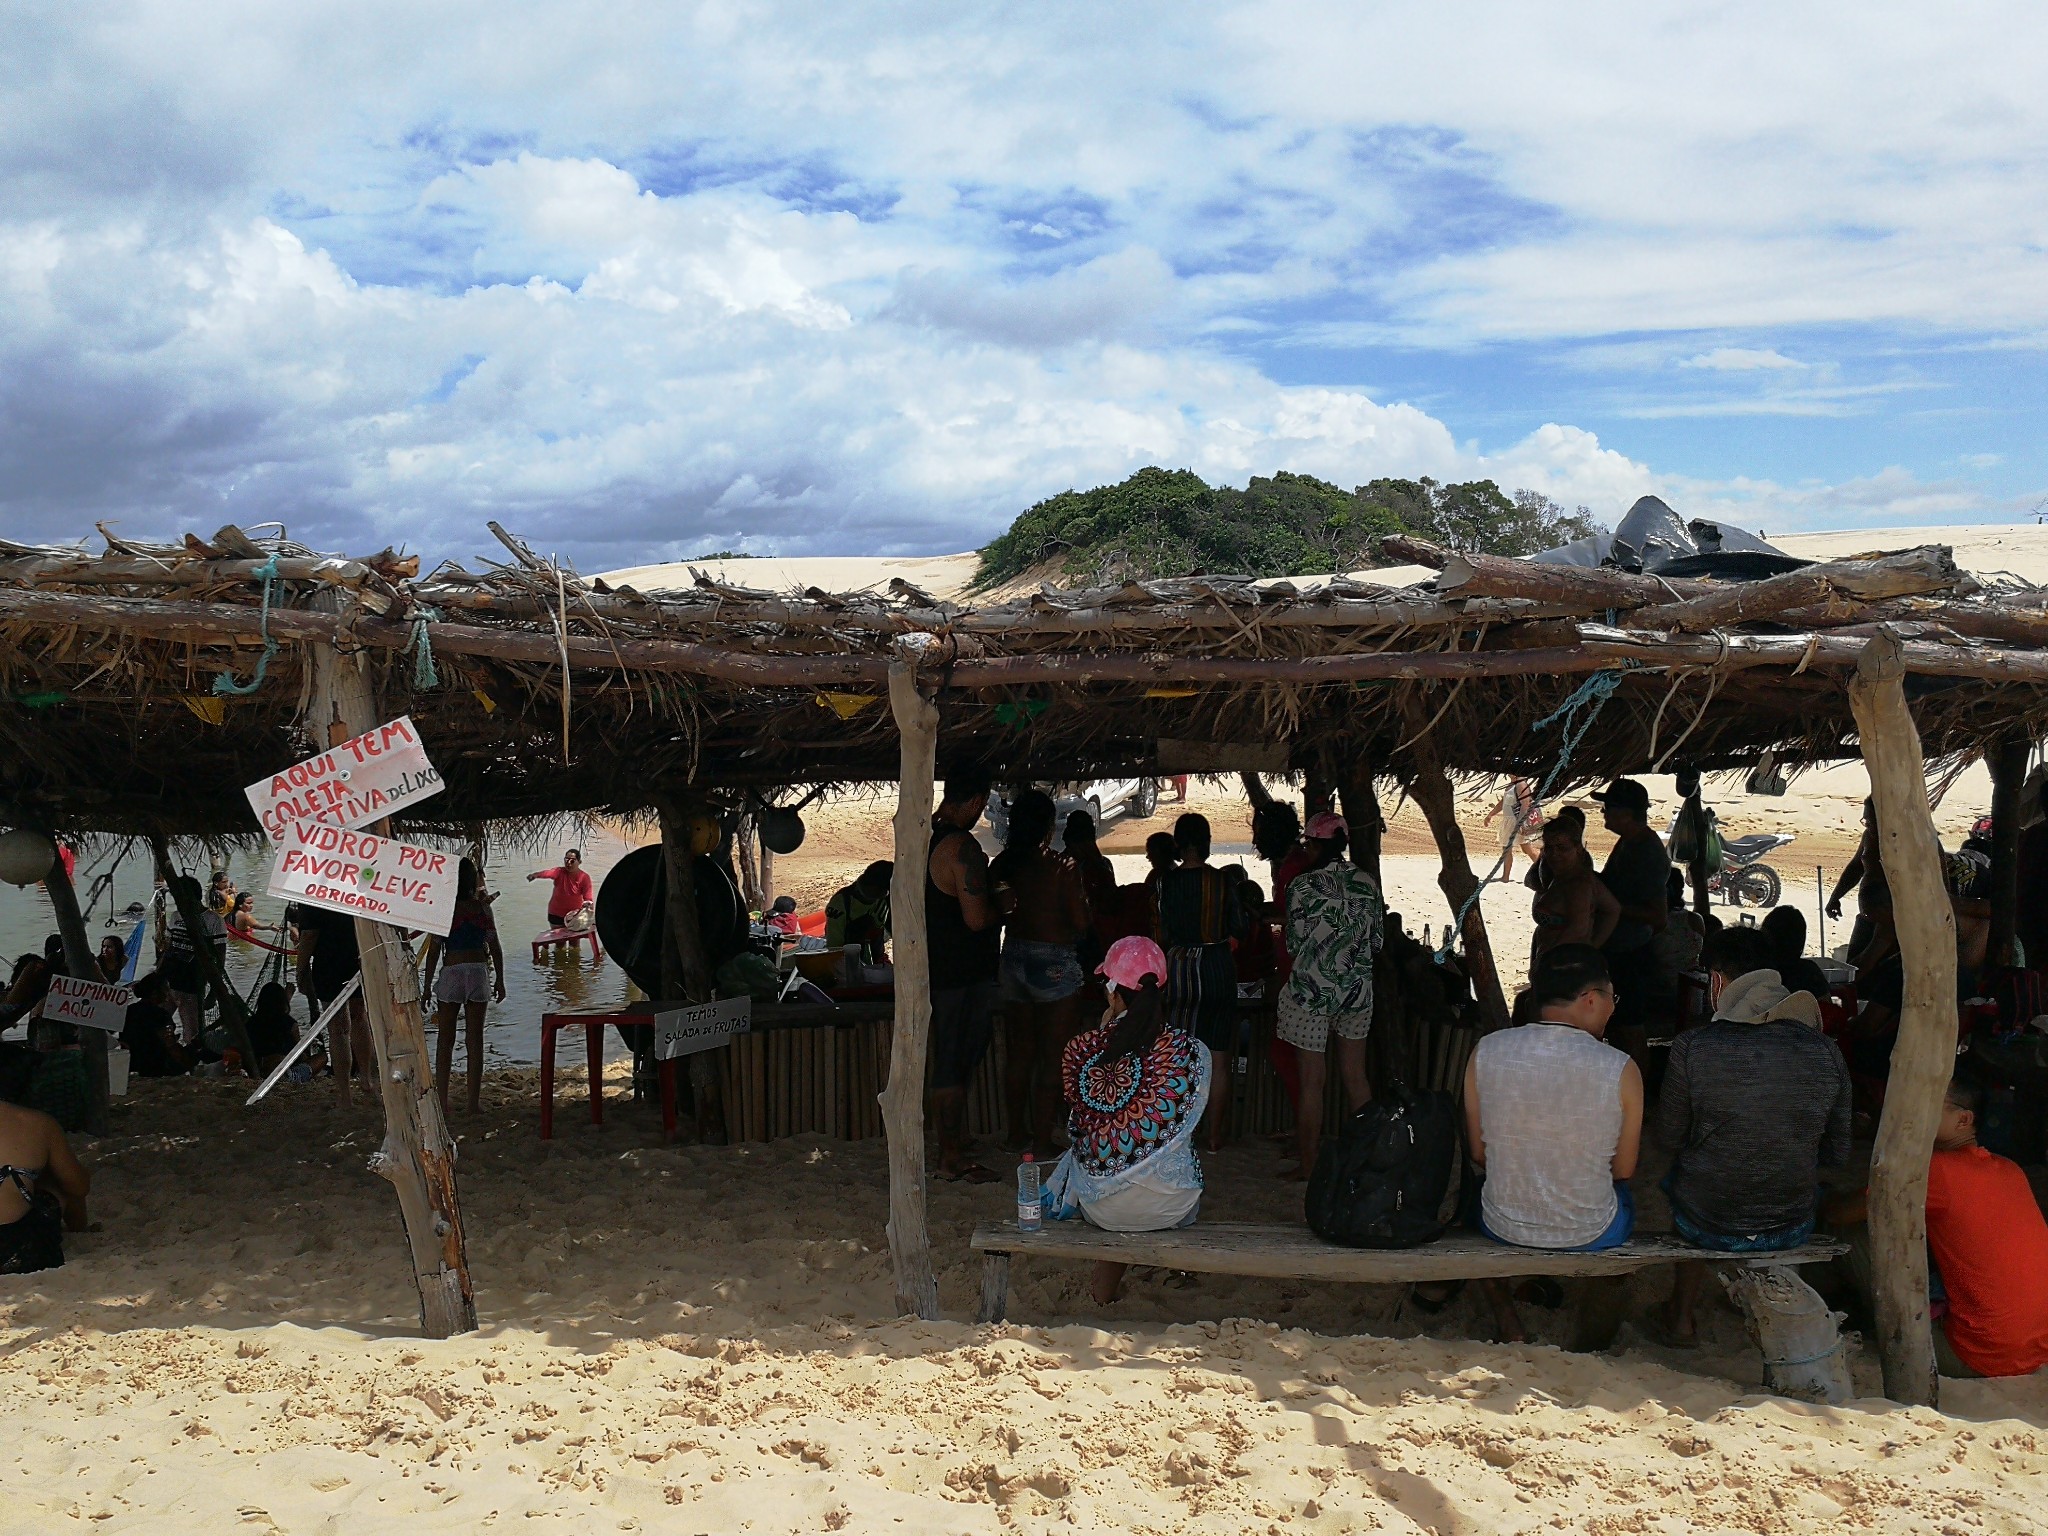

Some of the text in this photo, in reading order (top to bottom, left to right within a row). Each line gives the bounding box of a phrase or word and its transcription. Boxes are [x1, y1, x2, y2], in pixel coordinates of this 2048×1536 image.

[270, 721, 413, 797] AQUI TEM
[402, 768, 441, 792] LIXO
[262, 779, 355, 831] COLETA
[398, 845, 446, 875] POR
[281, 849, 433, 905] FAVOR LEVE.
[305, 883, 391, 914] OBRIGADO.
[58, 1000, 95, 1019] AQUI
[686, 1007, 717, 1023] TEMOS
[664, 1027, 700, 1045] SALADA
[714, 1015, 748, 1035] FRUTAS
